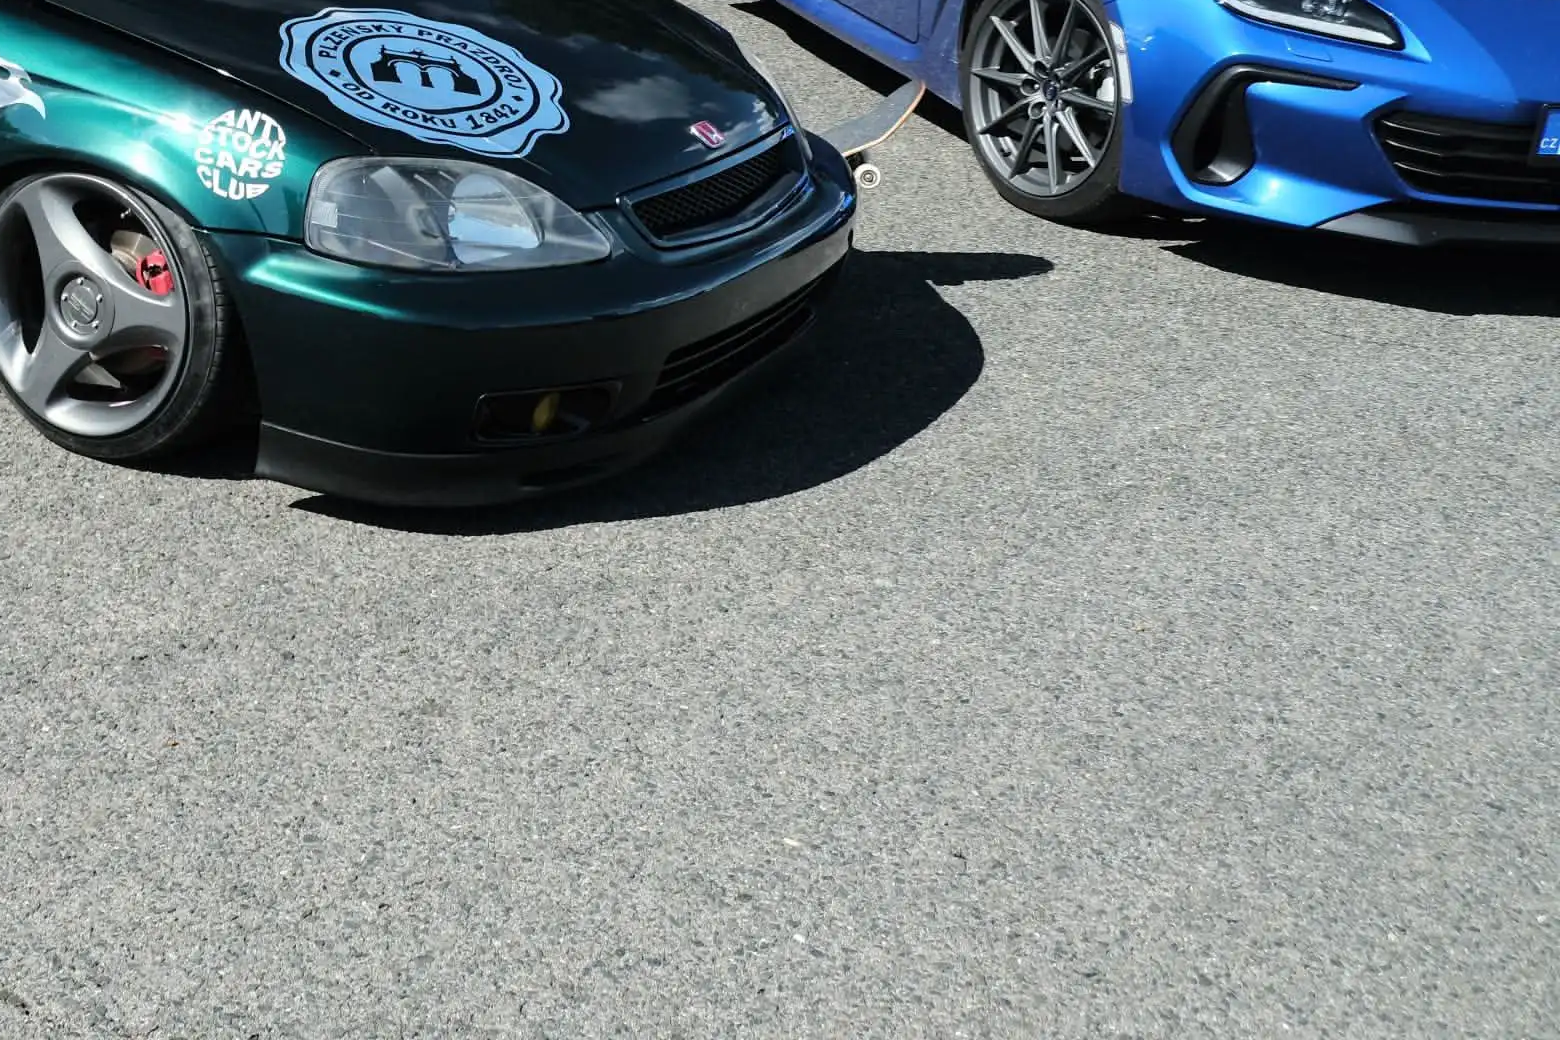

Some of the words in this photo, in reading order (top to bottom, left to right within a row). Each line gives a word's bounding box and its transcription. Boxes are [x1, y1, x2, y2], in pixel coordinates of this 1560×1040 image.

[417, 28, 527, 92] PRAZDROJ
[342, 81, 376, 101] OD
[381, 102, 457, 130] ROKU
[465, 103, 520, 131] 1842
[197, 125, 286, 161] STOCK
[206, 108, 287, 144] ANTI
[1540, 137, 1559, 150] CZ
[195, 147, 284, 178] CARS
[196, 164, 271, 200] CLUB
